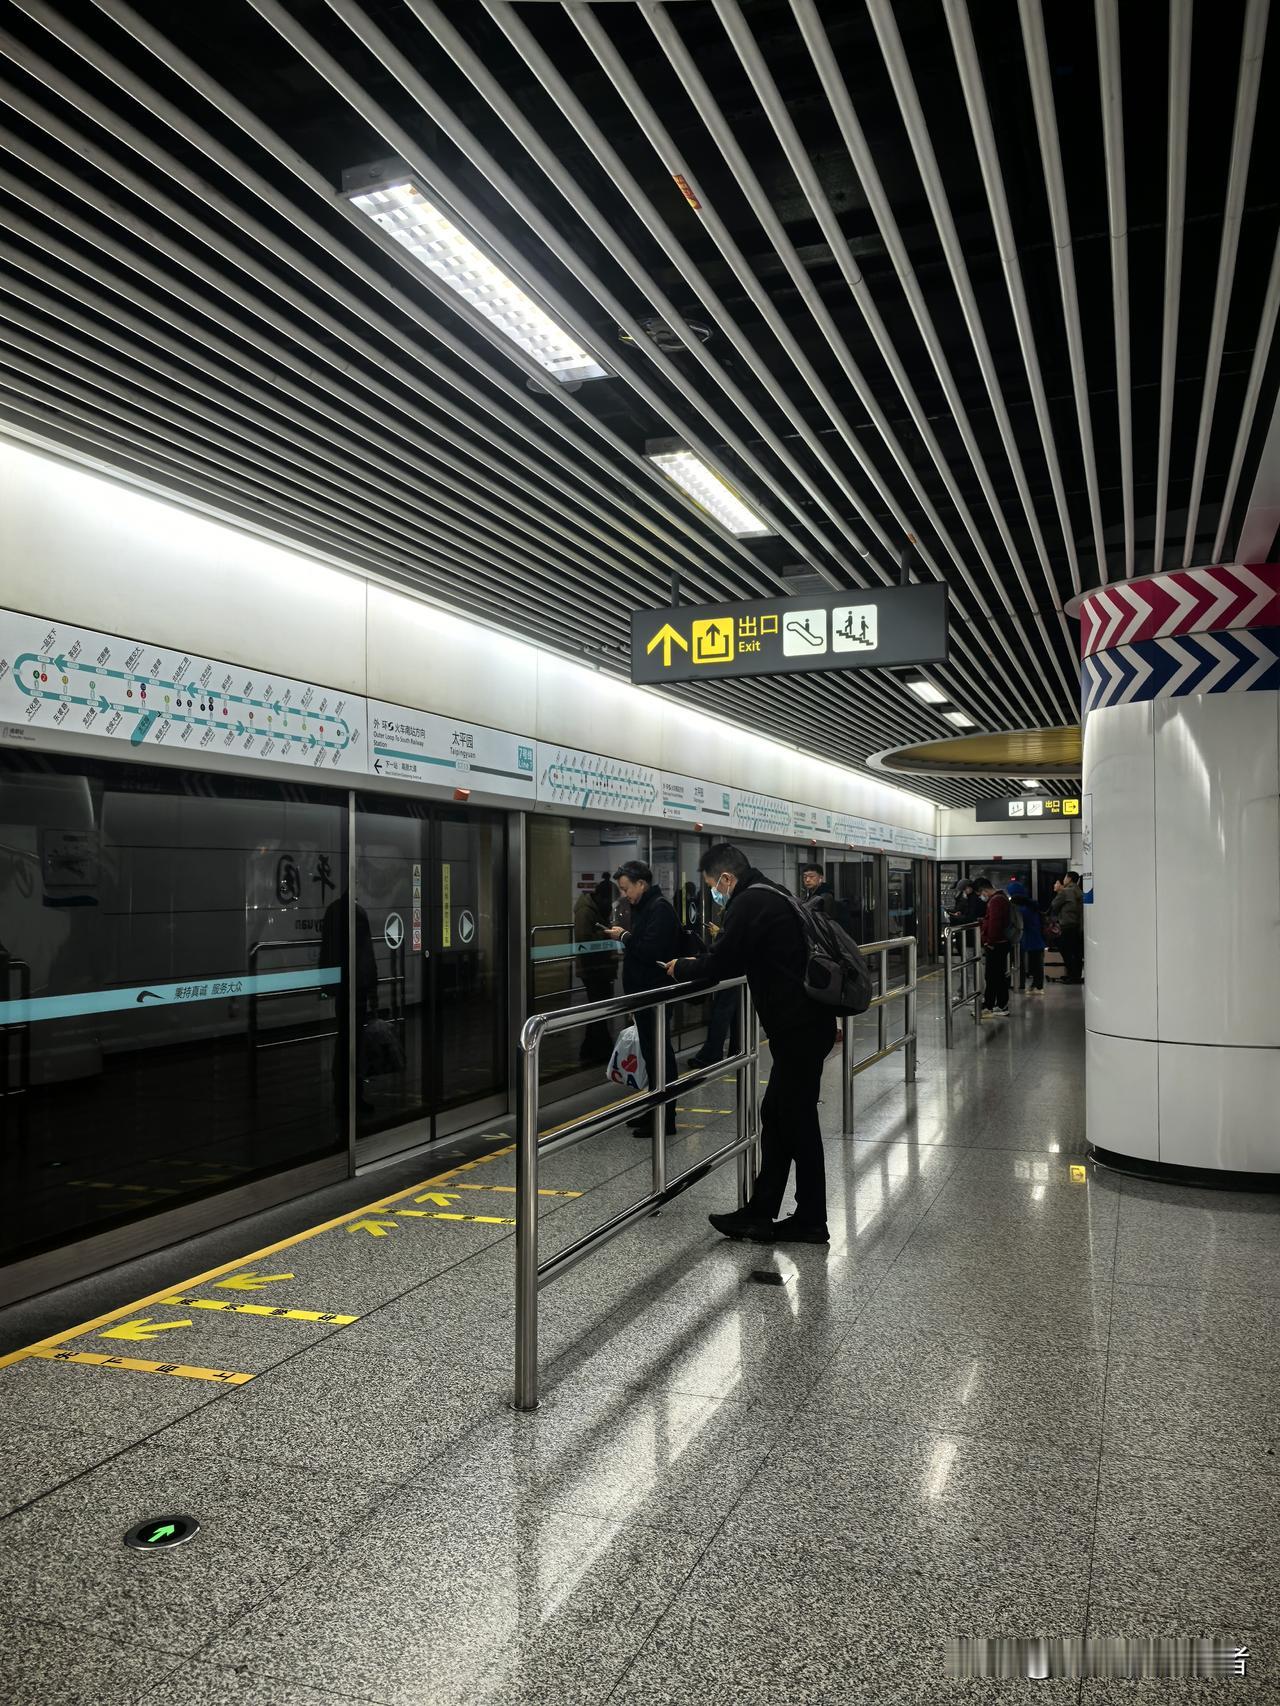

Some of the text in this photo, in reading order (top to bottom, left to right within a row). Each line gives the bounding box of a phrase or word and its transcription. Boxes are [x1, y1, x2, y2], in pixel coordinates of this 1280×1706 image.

[739, 615, 778, 635] 出口
[41, 628, 56, 650] 一品天下
[739, 640, 760, 652] Exit
[25, 697, 40, 715] 文化宫
[395, 723, 425, 739] 火车南站方向
[373, 731, 384, 739] Outer
[385, 733, 395, 742] Loop
[410, 738, 424, 748] Railway
[373, 740, 387, 748] Station
[452, 731, 473, 749] 太平园
[450, 747, 476, 759] Taipingyuan
[1045, 800, 1060, 808] 出口
[211, 980, 243, 995] 服务大众
[54, 1351, 236, 1380] 先下后上
